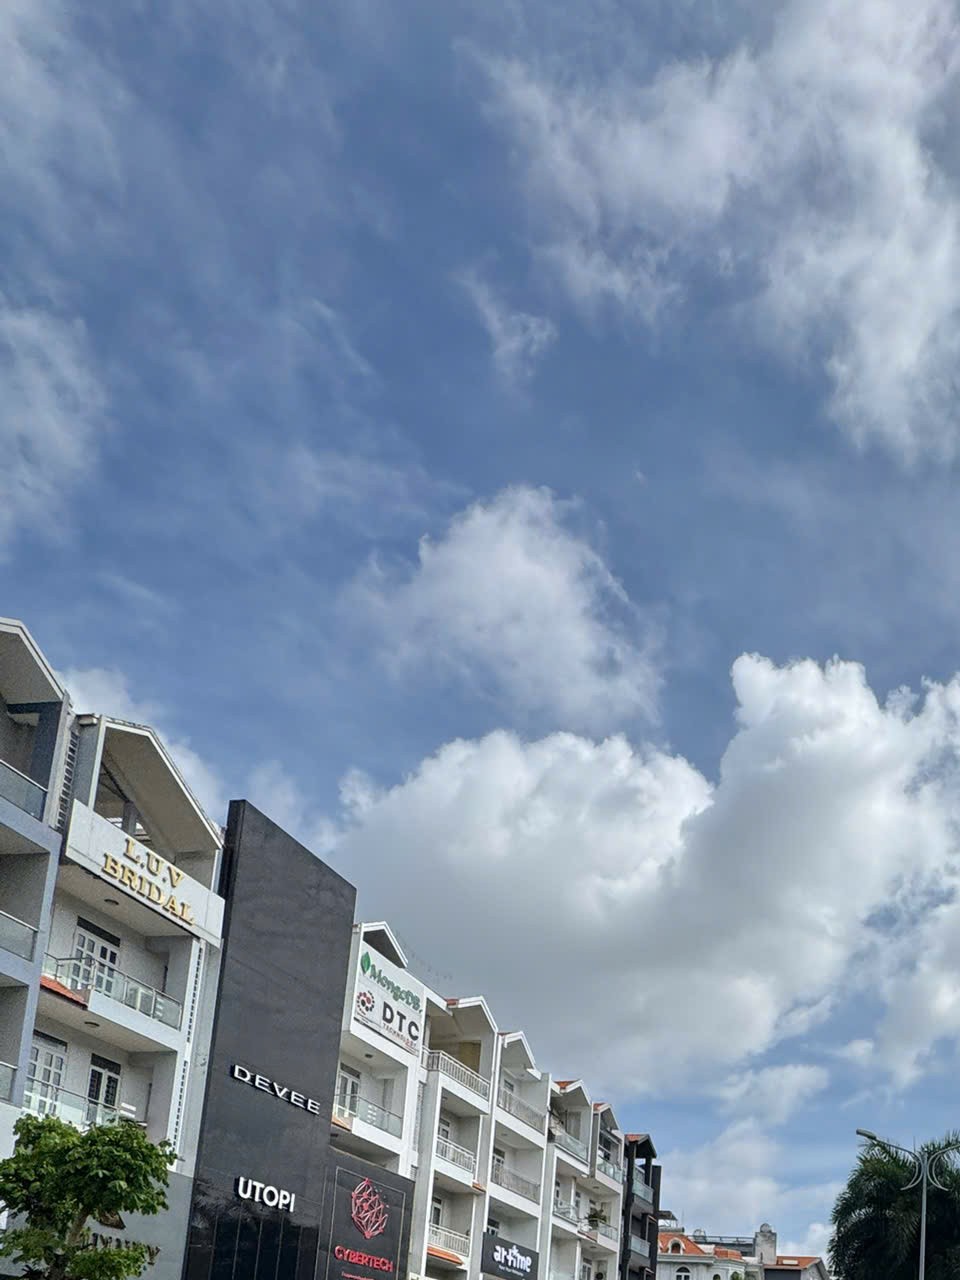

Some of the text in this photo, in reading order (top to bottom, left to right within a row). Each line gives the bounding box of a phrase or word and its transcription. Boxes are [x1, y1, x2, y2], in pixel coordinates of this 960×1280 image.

[123, 838, 184, 888] L.U.V
[101, 853, 195, 926] BRIDAL
[382, 1001, 420, 1041] DTC
[232, 1064, 321, 1115] DEVEE
[236, 1176, 296, 1213] UTOPI
[334, 1245, 394, 1272] CYBERTECH
